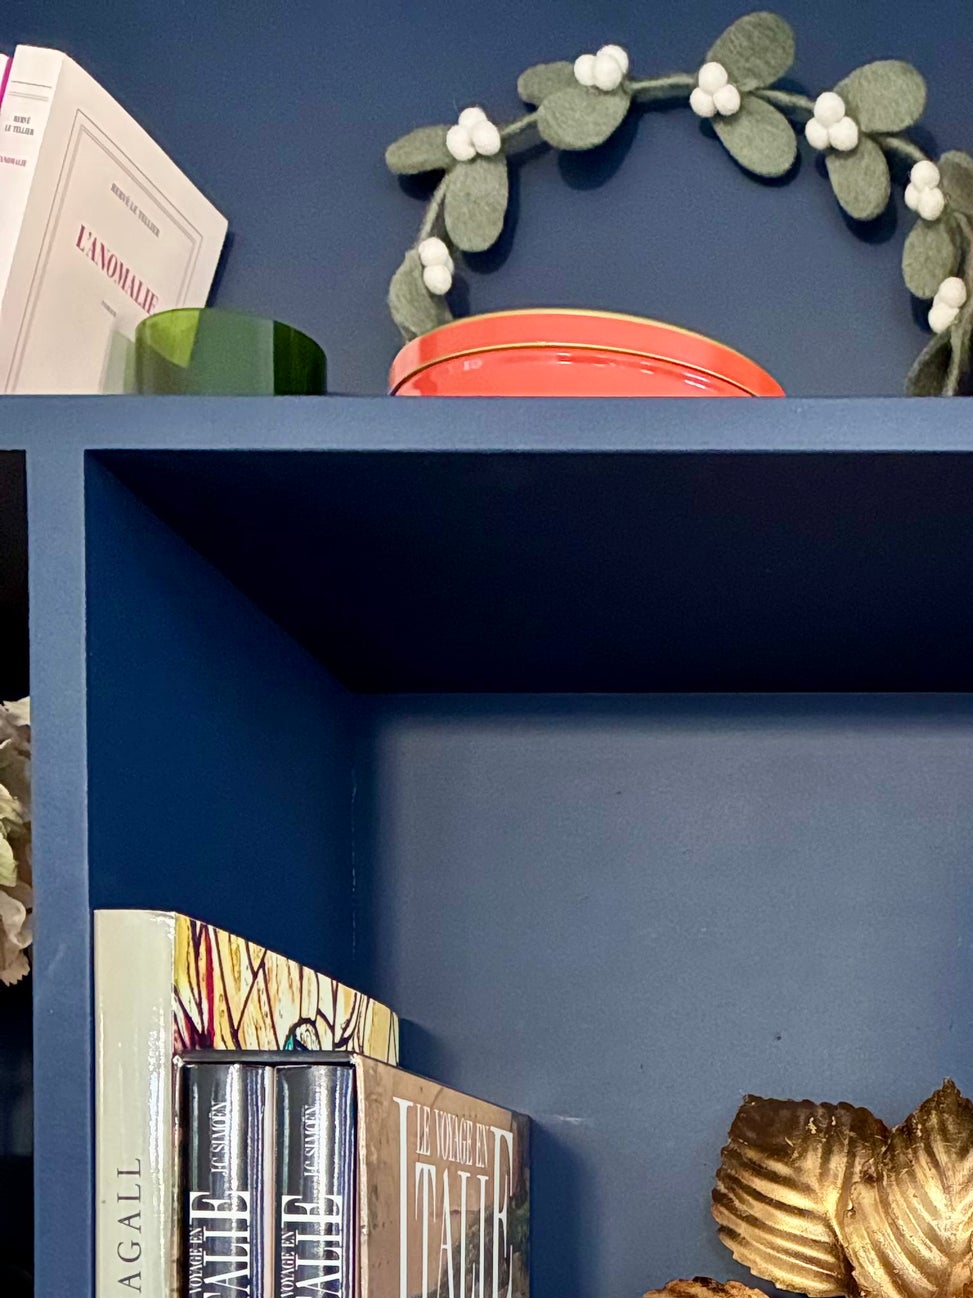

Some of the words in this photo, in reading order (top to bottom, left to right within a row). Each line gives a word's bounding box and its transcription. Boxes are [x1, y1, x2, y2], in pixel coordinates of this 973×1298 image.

[76, 223, 159, 315] L'ANOMALIE
[415, 1104, 431, 1156] LE
[434, 1109, 473, 1166] VOYAGE
[476, 1123, 489, 1168] EN
[189, 1227, 202, 1244] EN
[281, 1231, 295, 1247] EN
[189, 1247, 203, 1294] VOYAGE
[280, 1251, 295, 1297] VOYAGE
